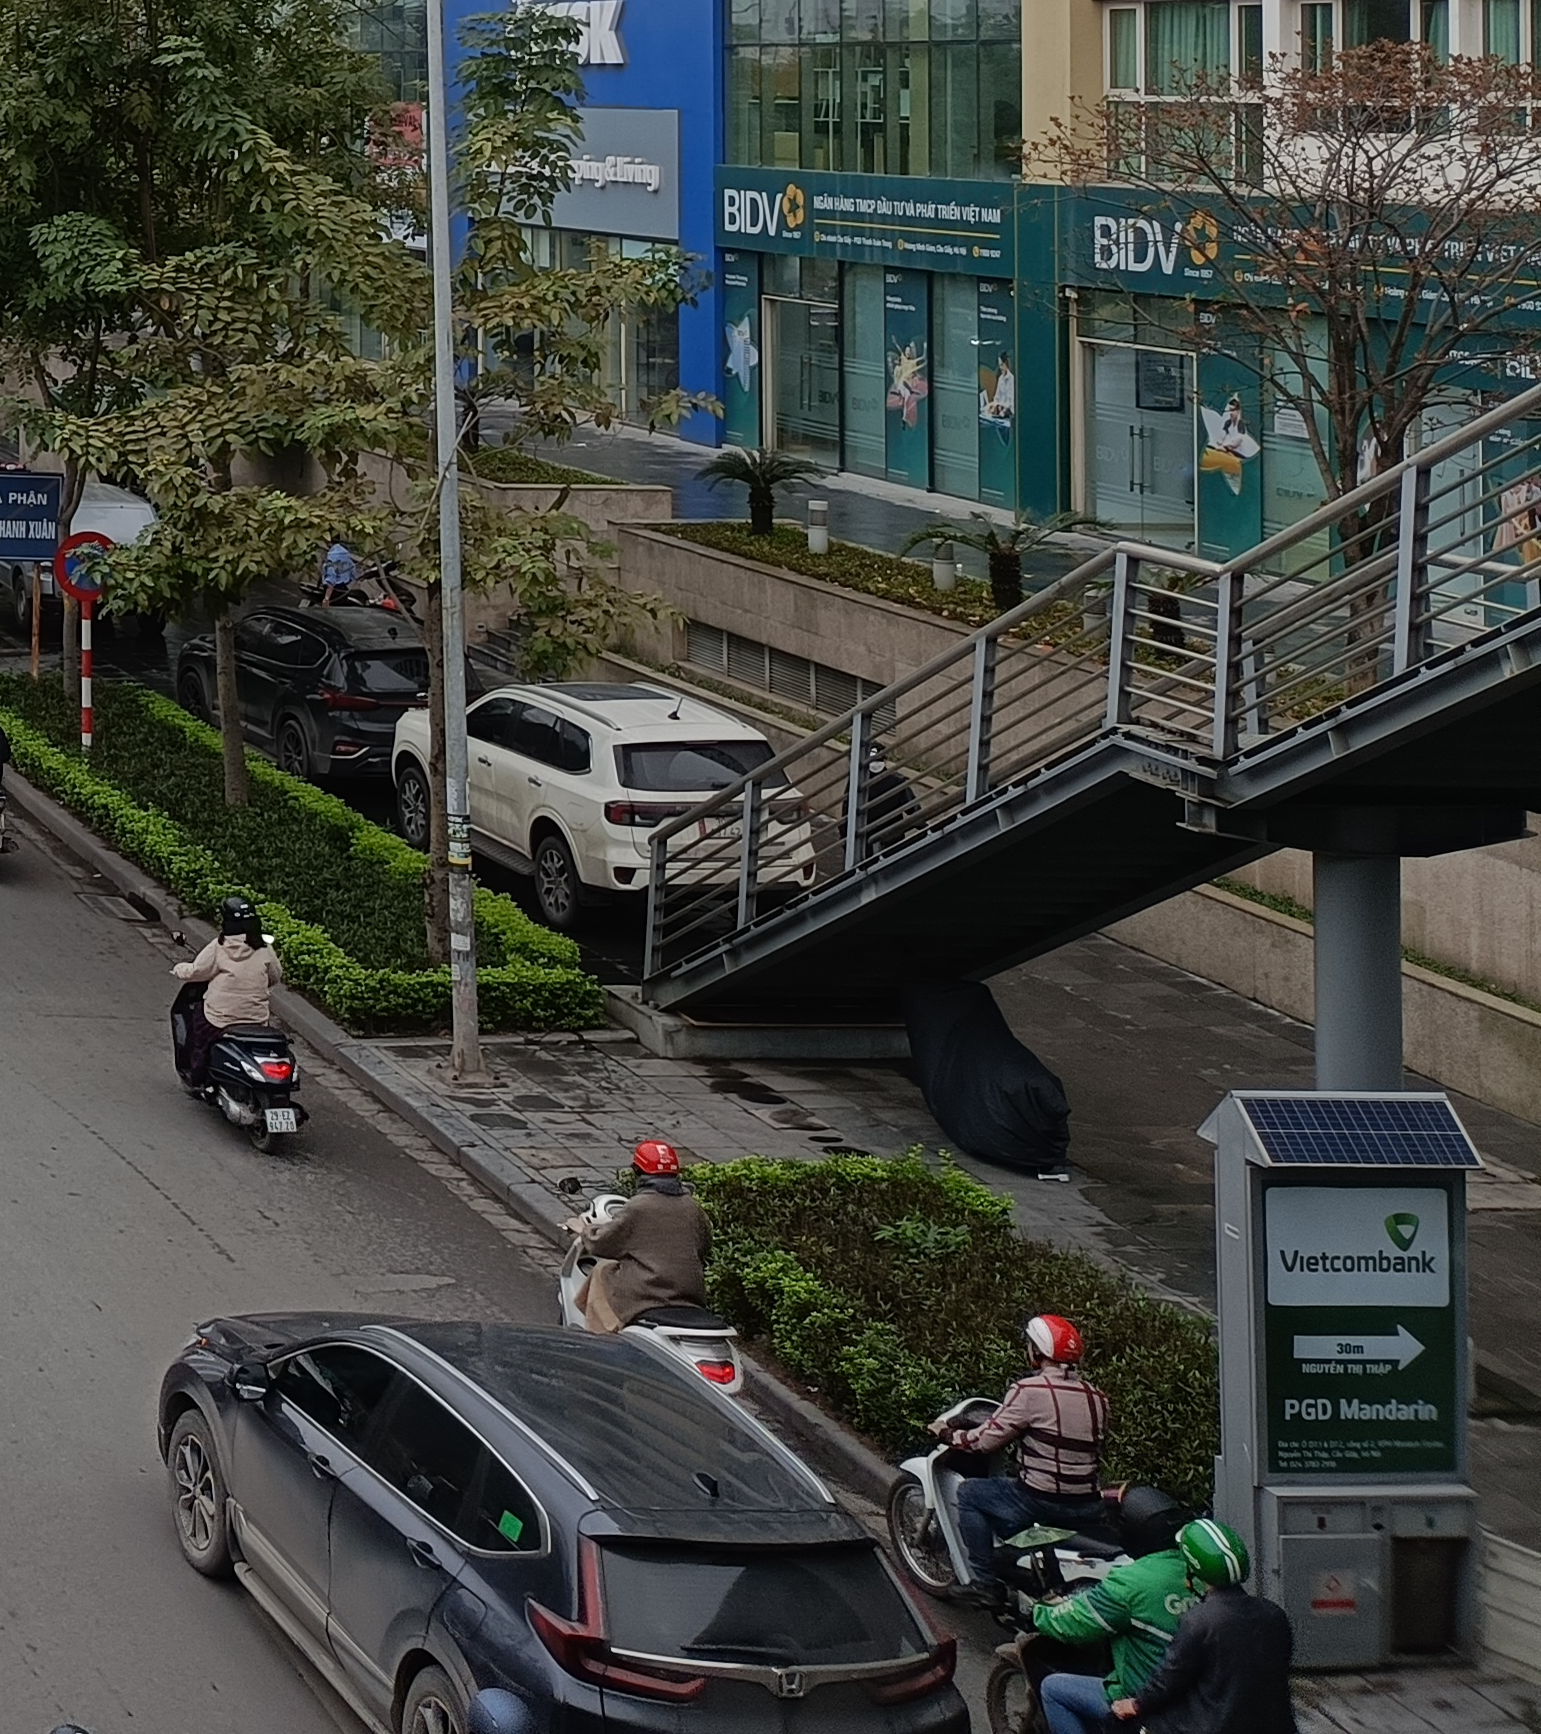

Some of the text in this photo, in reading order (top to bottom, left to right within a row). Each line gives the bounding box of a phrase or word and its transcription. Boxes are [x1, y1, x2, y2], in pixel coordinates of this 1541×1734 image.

[724, 188, 783, 237] BIDV
[813, 193, 833, 210] NGÂN
[834, 194, 854, 212] HÀNG
[855, 198, 876, 213] TMCP
[904, 199, 915, 217] VÀ
[915, 201, 936, 218] PHÁT
[961, 203, 980, 225] VIỆT
[981, 207, 1001, 223] NAM
[1094, 216, 1183, 275] BIDV
[8, 490, 47, 507] PHẬN
[28, 518, 56, 539] XUÂN
[1279, 1250, 1436, 1274] Vietcombank
[1336, 1343, 1364, 1354] 30m
[1302, 1362, 1392, 1376] NGUYỄN THỊ THẬP
[1284, 1398, 1438, 1421] PGD Mandarin
